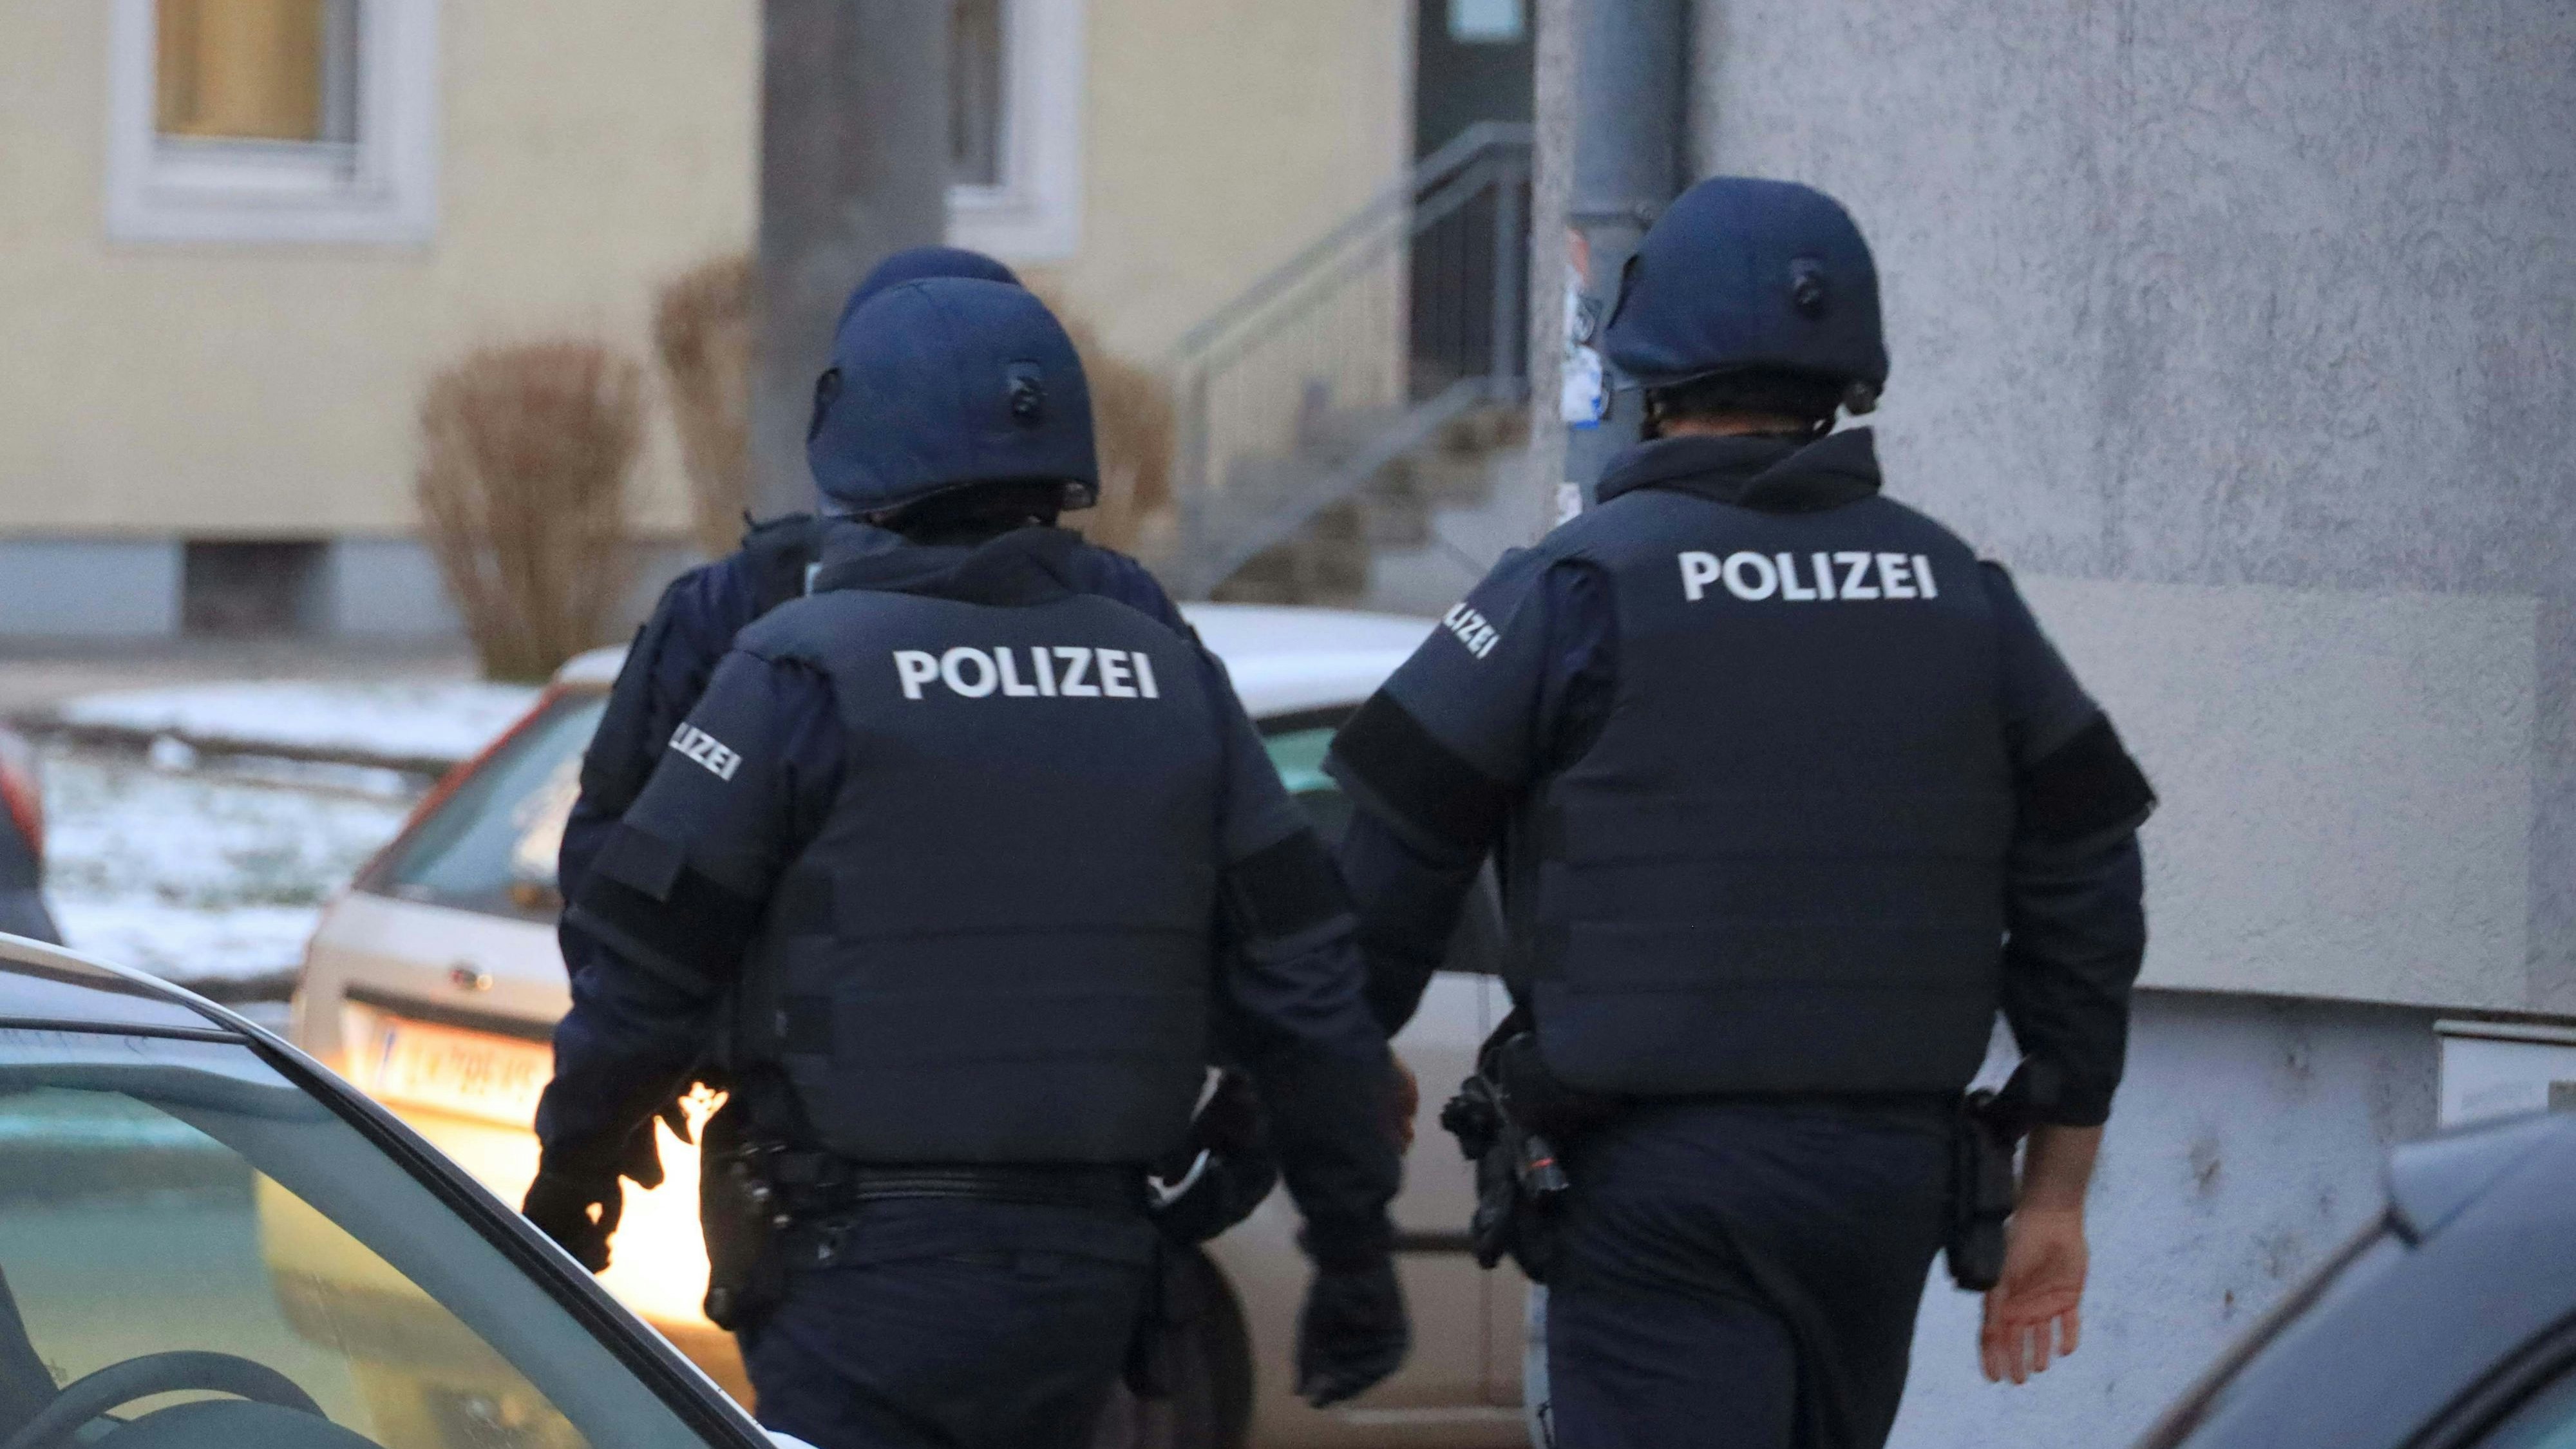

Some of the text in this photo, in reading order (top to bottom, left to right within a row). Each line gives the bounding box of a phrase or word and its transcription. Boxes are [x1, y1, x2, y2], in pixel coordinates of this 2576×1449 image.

[1678, 551, 1937, 601] POLIZEI
[1444, 602, 1500, 659] LIZEI
[893, 646, 1159, 699] POLIZEI
[669, 722, 742, 781] LIZEI
